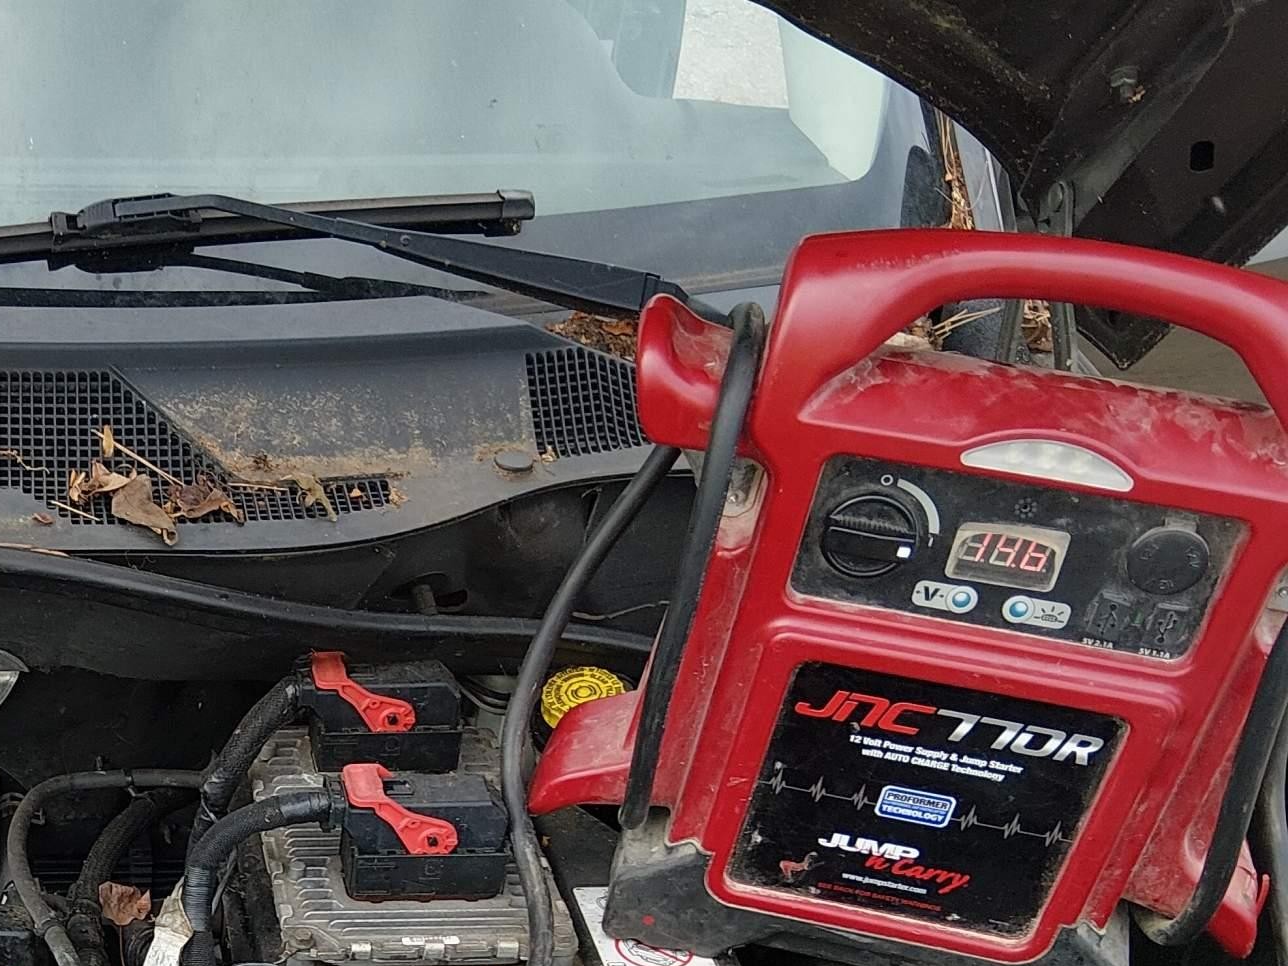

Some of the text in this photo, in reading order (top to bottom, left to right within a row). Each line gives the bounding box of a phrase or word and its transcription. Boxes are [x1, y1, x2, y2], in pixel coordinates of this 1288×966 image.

[849, 734, 1023, 774] 12 Volt Power Supply & Jump Starter
[861, 748, 1005, 782] with AUTO CHARGE Technology
[886, 791, 948, 811] PROFORMER
[818, 832, 919, 860] JUMP
